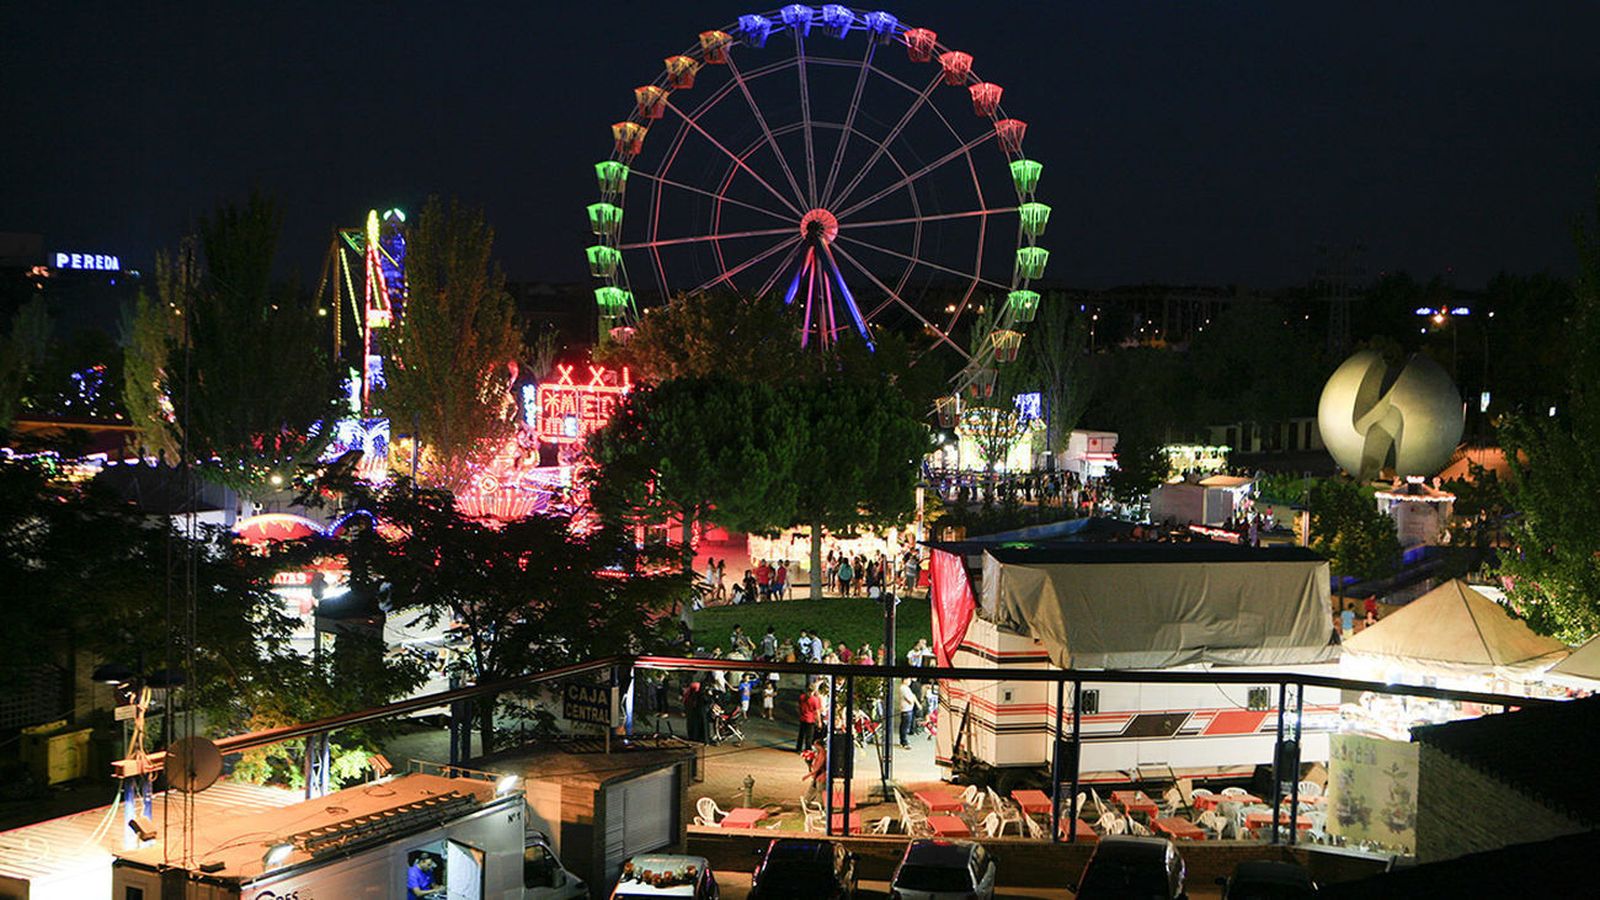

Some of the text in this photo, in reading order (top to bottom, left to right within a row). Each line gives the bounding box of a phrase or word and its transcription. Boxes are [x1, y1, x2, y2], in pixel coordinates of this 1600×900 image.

[56, 253, 120, 271] PEREDA
[568, 685, 608, 705] CAJA
[565, 702, 610, 723] CENTRAL
